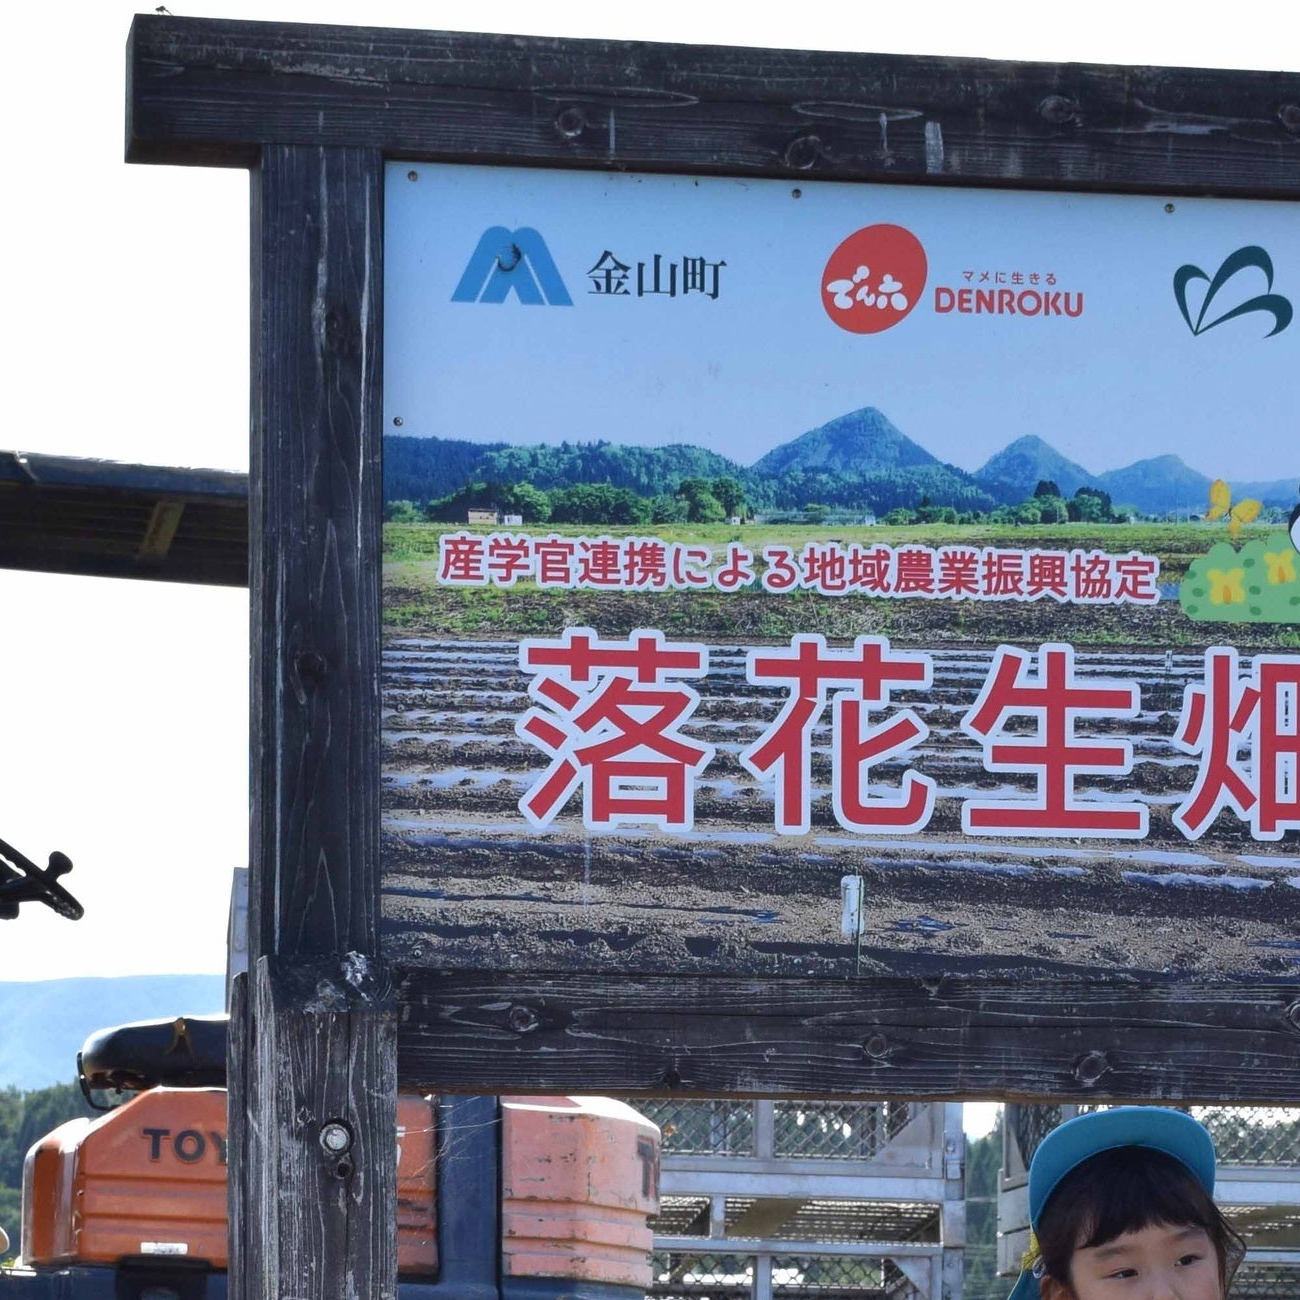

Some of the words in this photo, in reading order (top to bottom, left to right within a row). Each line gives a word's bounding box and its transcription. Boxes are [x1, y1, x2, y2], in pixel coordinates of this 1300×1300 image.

[586, 249, 728, 300] 金山町
[826, 264, 909, 312] でん六
[961, 270, 1058, 286] マメに生きる
[934, 286, 1084, 318] DENROKU
[438, 534, 1160, 601] 産学官連携による地域農業振興協定
